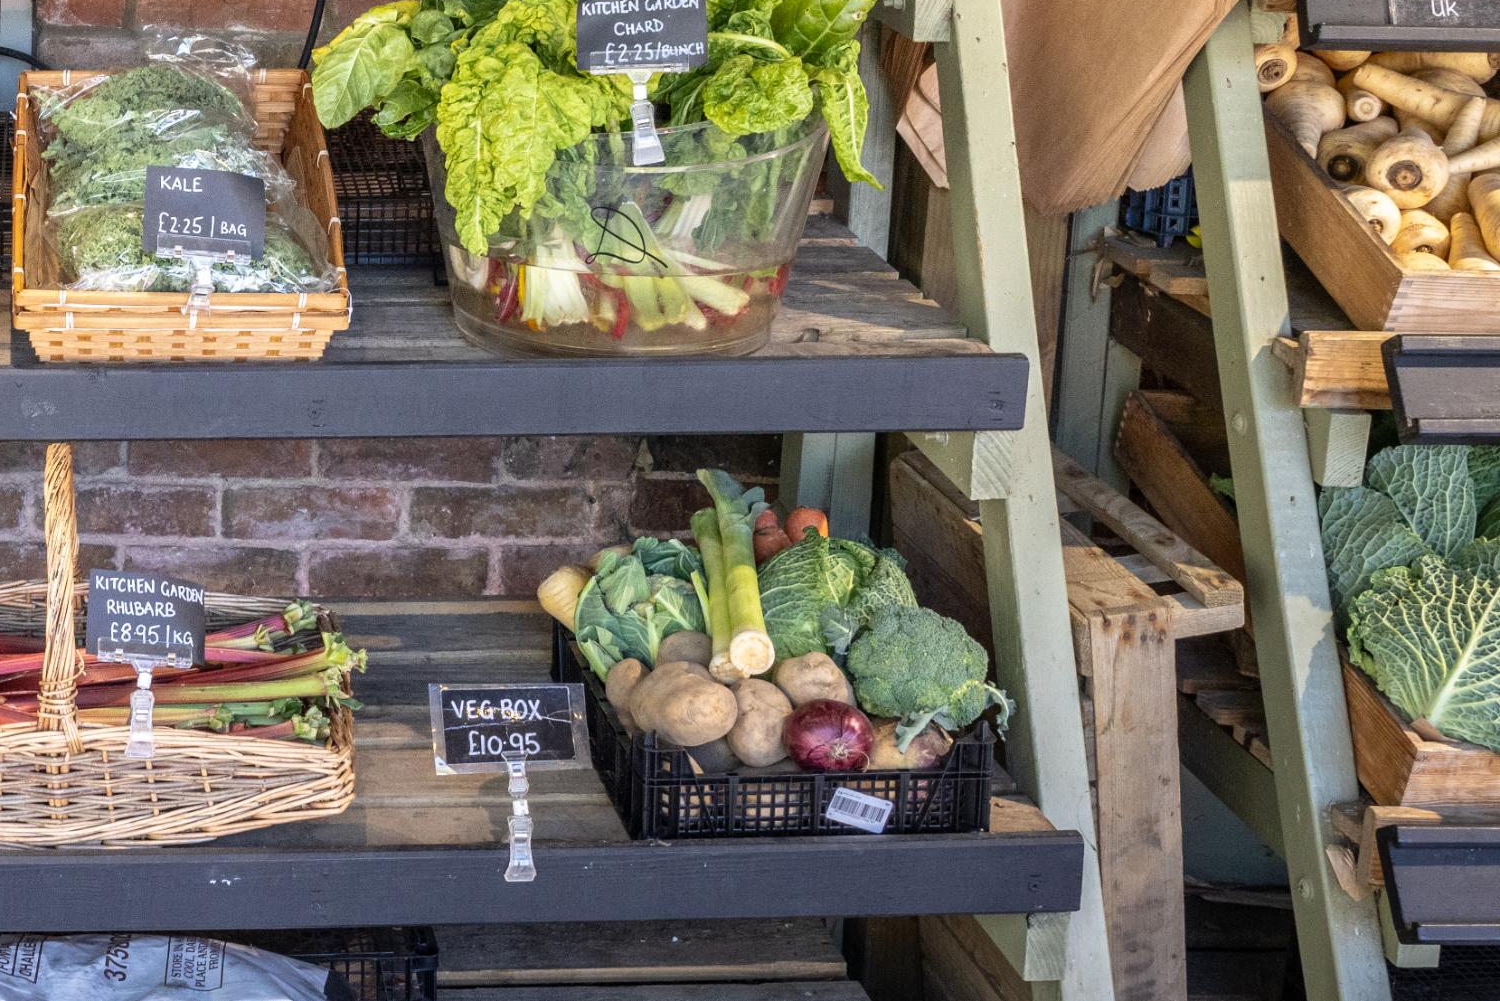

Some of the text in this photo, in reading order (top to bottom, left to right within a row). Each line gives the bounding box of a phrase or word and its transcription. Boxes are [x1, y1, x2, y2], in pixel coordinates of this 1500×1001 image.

[613, 18, 664, 36] CHARD
[160, 175, 203, 193] KALE
[95, 576, 204, 605] KITCHEN GARDEN
[107, 599, 176, 617] RHUBARB
[450, 698, 543, 720] VEG BOX
